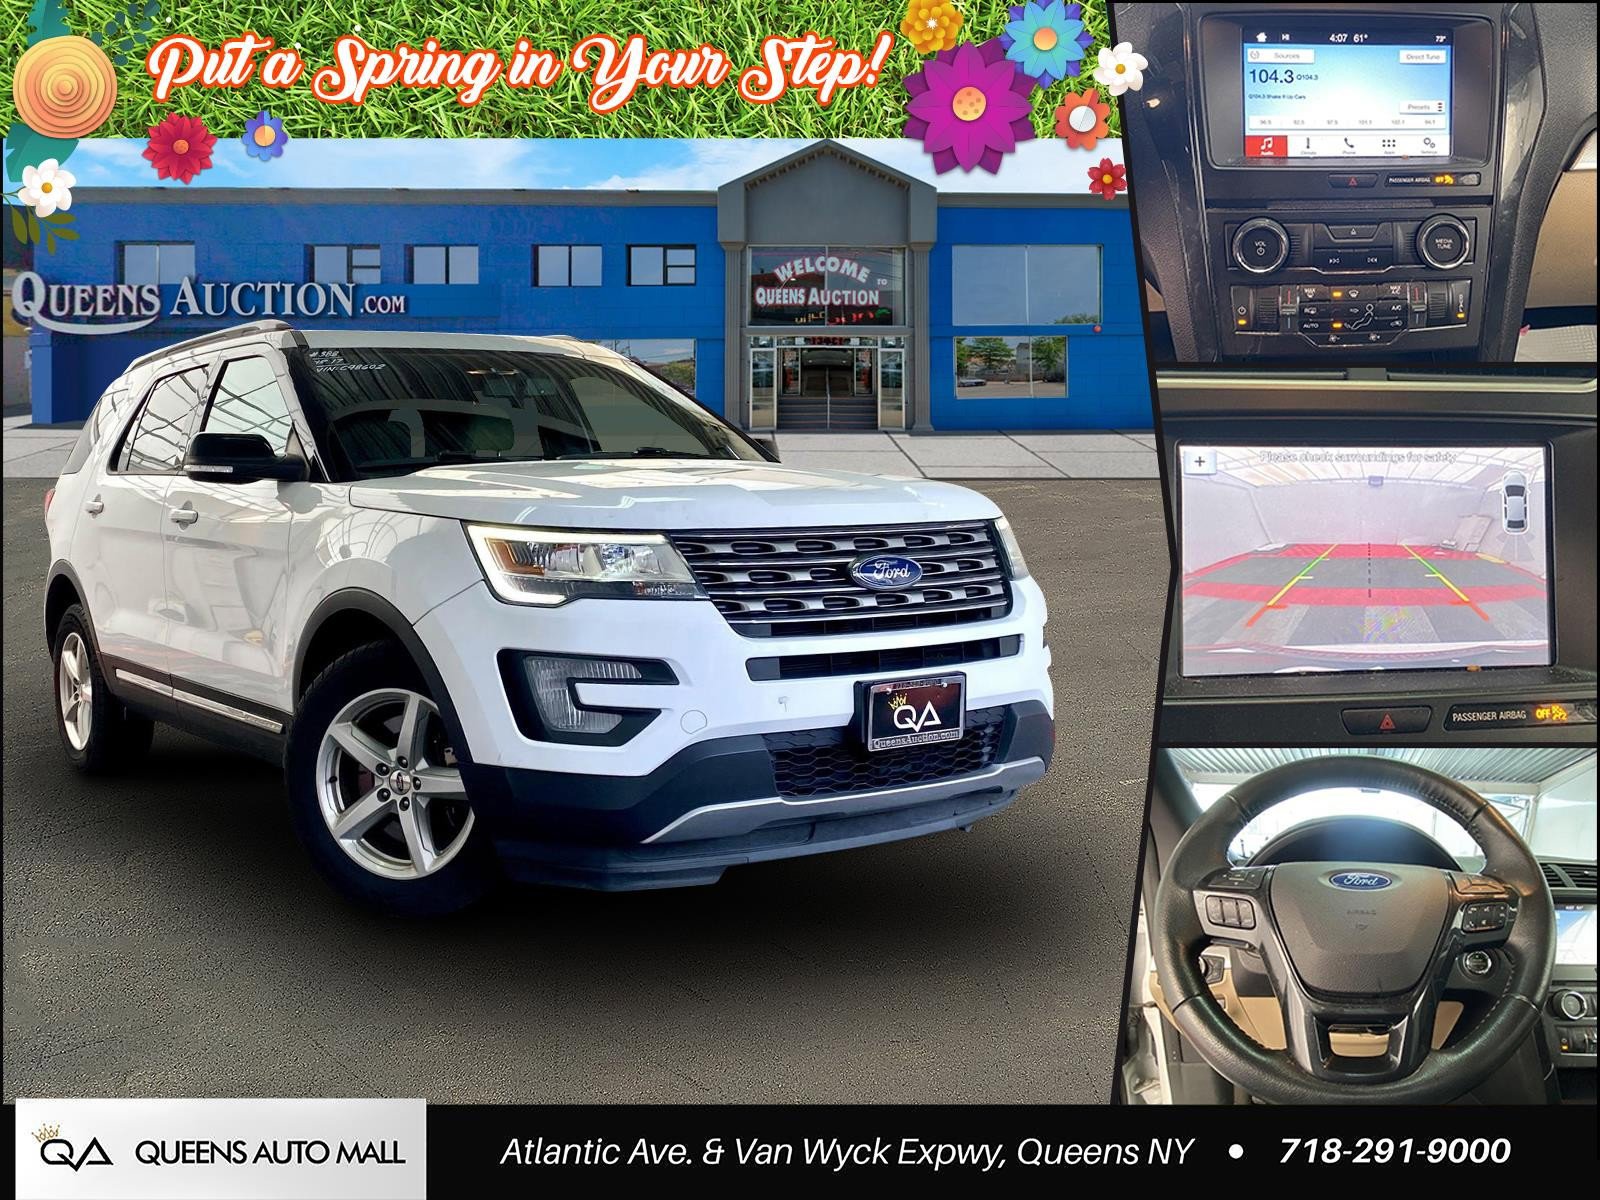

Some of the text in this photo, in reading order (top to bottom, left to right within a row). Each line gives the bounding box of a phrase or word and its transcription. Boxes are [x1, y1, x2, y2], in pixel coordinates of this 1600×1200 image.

[1329, 34, 1348, 42] 4:07
[1249, 69, 1294, 84] 104.3
[774, 256, 888, 286] WELCOME TO
[11, 270, 161, 335] QUEENS
[755, 287, 879, 306] QUEENS AUCTION
[1259, 450, 1457, 464] Please check surroundings for safety
[872, 559, 912, 579] Ford
[1452, 708, 1551, 722] PASSENGER AIRBAG OFF
[873, 730, 959, 749] QueensAuction.com
[1343, 873, 1379, 886] Ford
